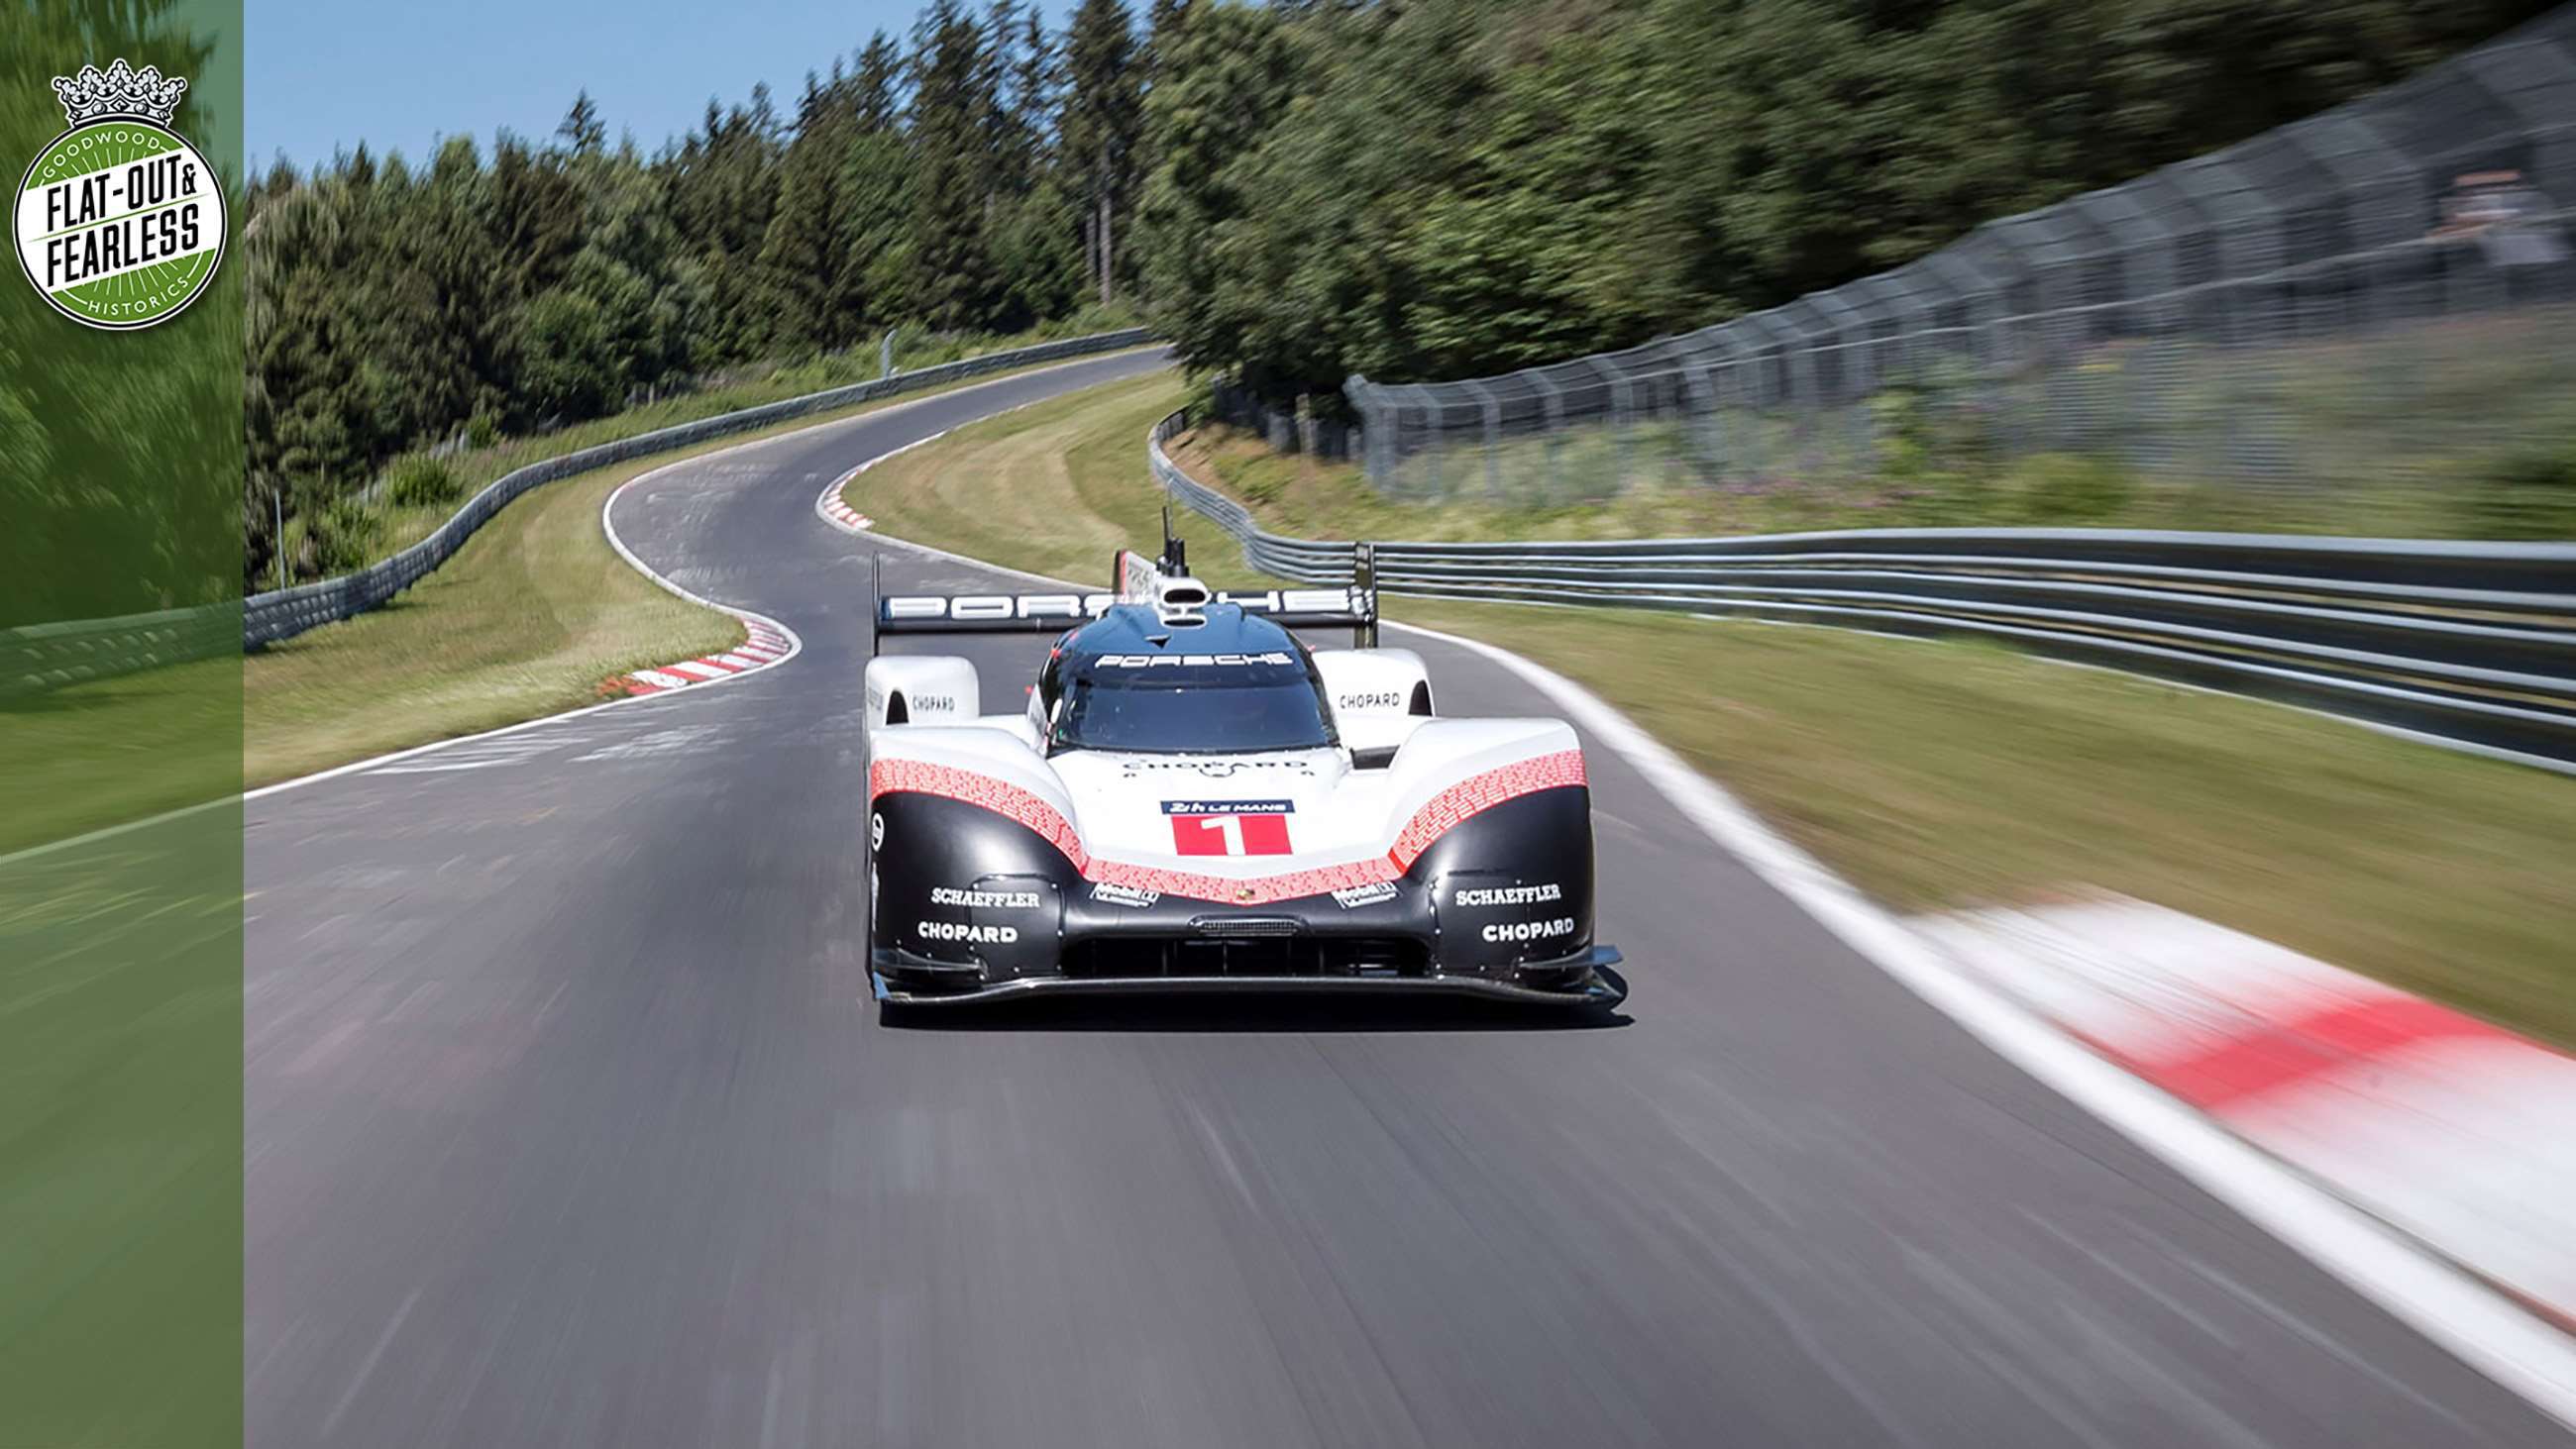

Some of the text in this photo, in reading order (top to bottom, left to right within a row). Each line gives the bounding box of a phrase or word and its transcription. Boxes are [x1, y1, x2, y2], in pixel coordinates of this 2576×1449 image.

[889, 594, 1350, 620] PORHE
[1094, 653, 1294, 669] PORSCHE
[912, 696, 955, 712] CHOPARD
[1340, 692, 1401, 709] CHOPARD
[1234, 803, 1287, 812] MANS
[1200, 815, 1246, 856] 1
[931, 887, 1040, 908] SCHAEFFLER
[1454, 882, 1561, 906] SCHAEFFLER
[917, 921, 1019, 943] CHOPARD
[1481, 917, 1574, 942] CHOPARD
